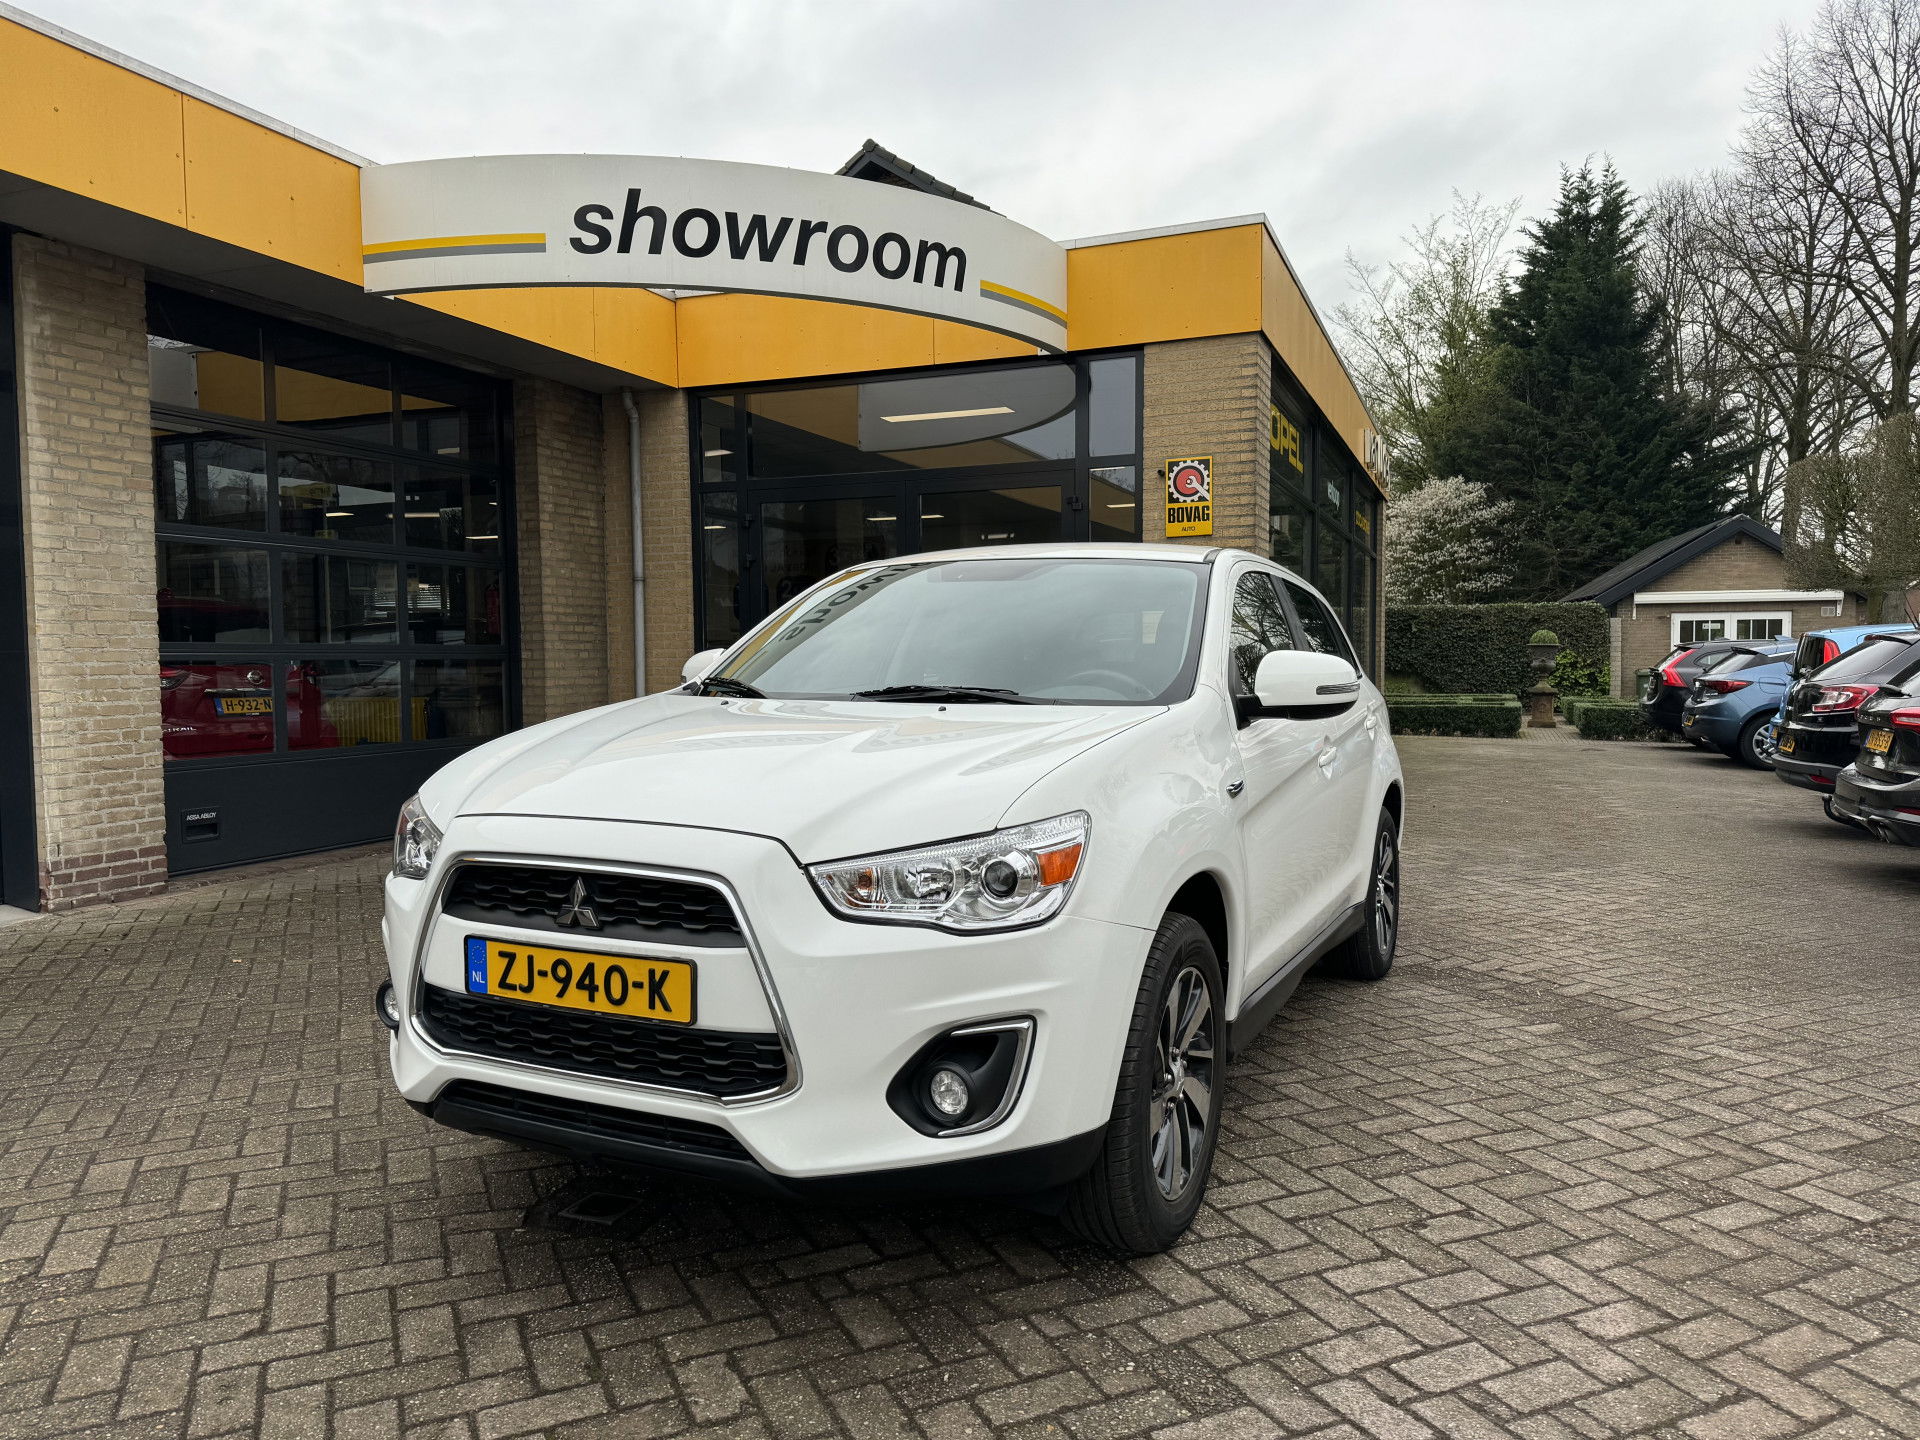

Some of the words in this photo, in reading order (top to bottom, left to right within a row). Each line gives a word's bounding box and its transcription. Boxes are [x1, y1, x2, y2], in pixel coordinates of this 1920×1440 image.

[569, 188, 967, 292] showroom
[1270, 403, 1304, 474] OPEL
[1168, 505, 1210, 523] BOVAG
[225, 699, 272, 711] H-932-N
[472, 970, 486, 984] NL
[498, 950, 672, 1013] ZJ-940-K
